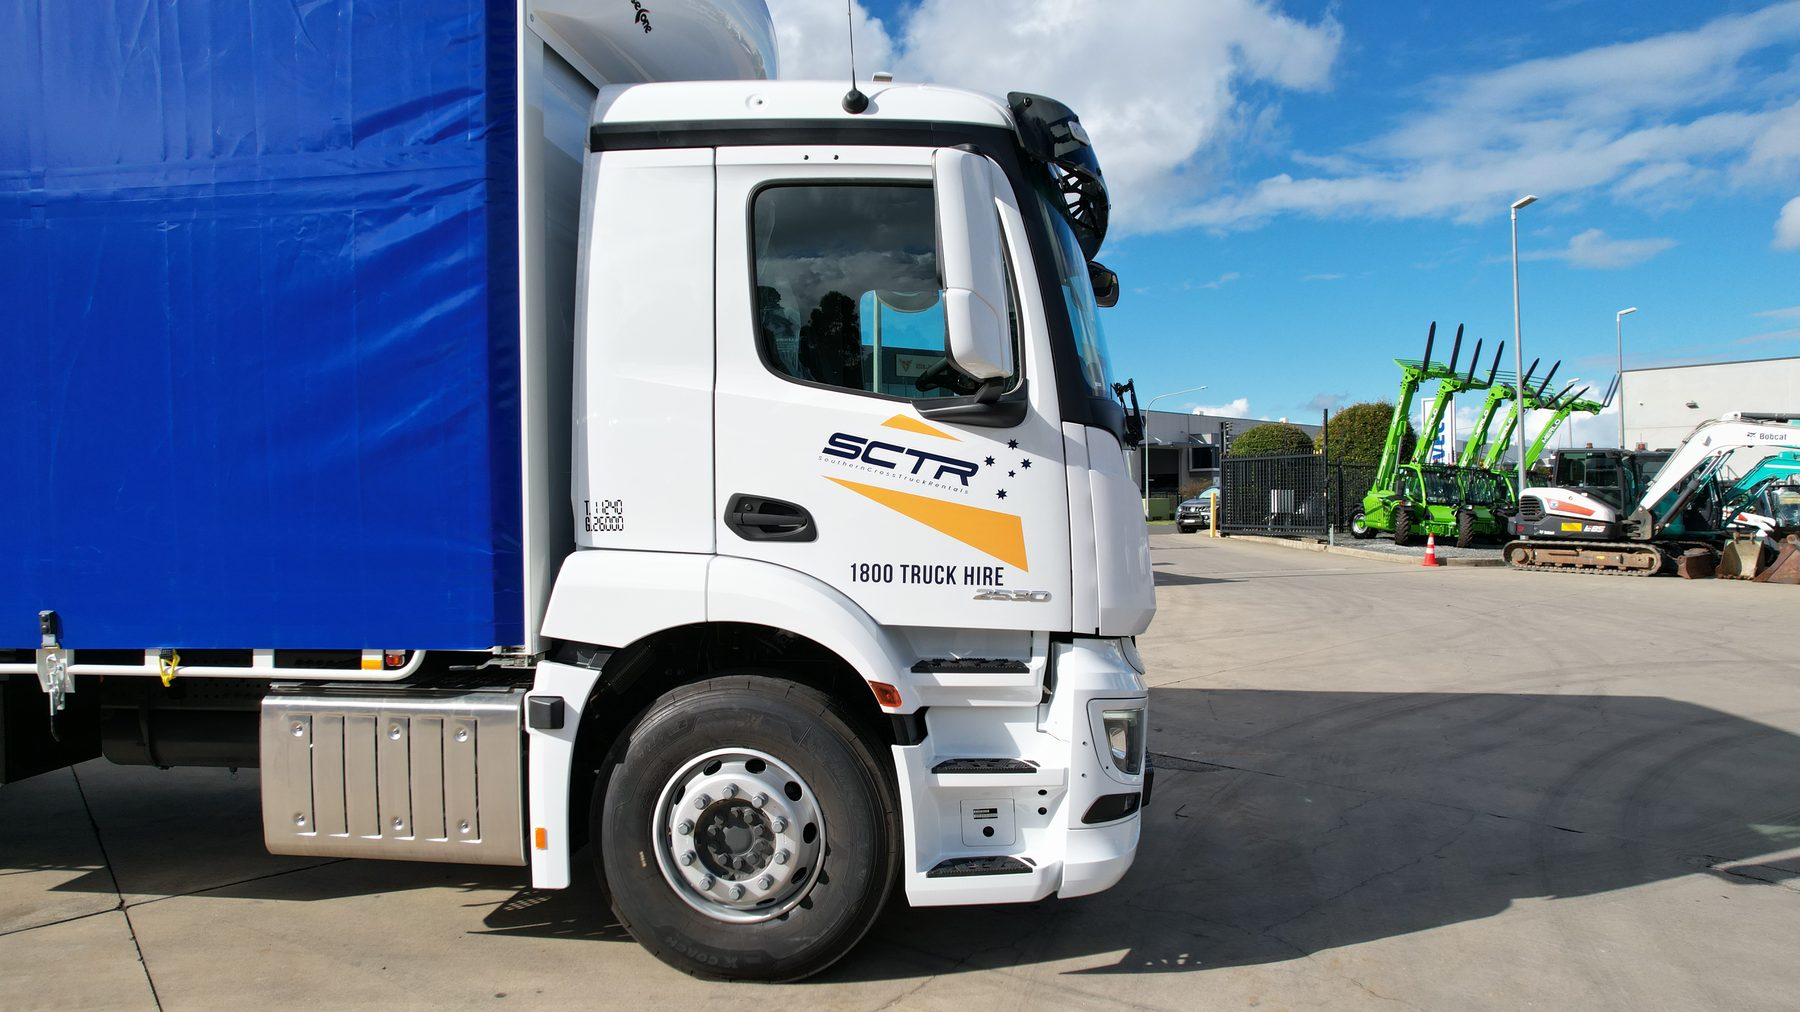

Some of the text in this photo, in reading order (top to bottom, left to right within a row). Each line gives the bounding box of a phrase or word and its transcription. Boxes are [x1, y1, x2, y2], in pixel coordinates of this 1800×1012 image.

[1759, 433, 1787, 441] Bobcat
[821, 432, 979, 487] SCTR
[850, 563, 1004, 586] 1800 TRUCK HIRE
